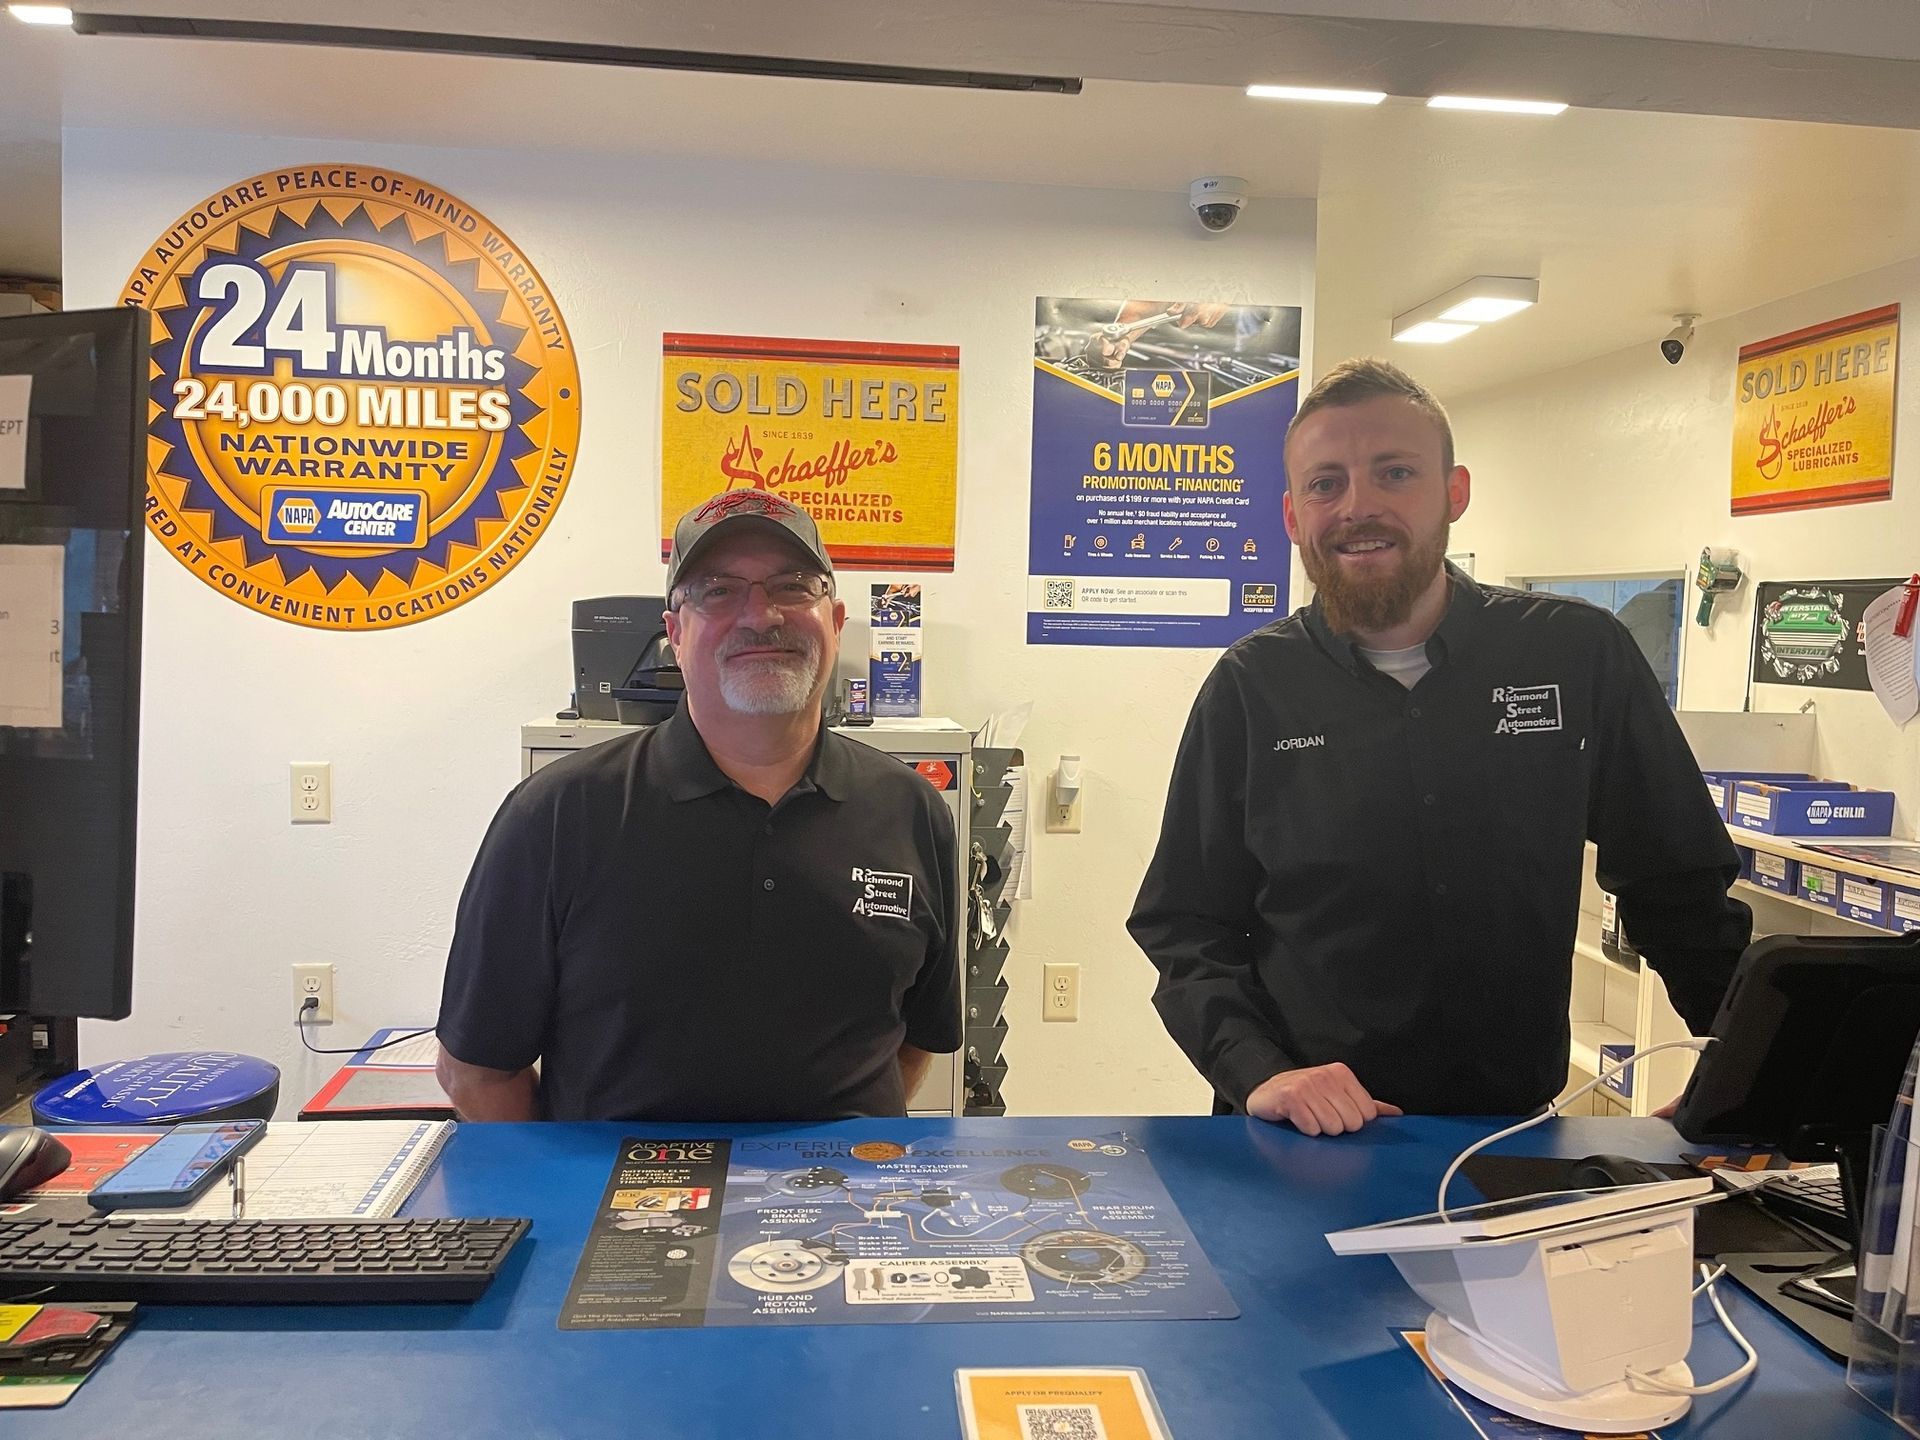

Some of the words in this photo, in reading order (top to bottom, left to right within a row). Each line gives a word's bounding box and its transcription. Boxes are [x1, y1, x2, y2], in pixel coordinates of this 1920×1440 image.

[124, 268, 159, 307] APA
[156, 181, 268, 263] AUTOCARE
[277, 170, 477, 233] PEACE-OF-MIND
[481, 231, 565, 352] WARRANTY
[197, 261, 337, 371] 24
[339, 329, 506, 381] Months
[1741, 359, 1807, 403] SOLD
[1814, 336, 1890, 387] HERE
[1155, 381, 1172, 391] NAPA
[172, 379, 348, 428] 24,000
[359, 386, 512, 431] MILES
[676, 371, 808, 416] SOLD
[823, 377, 947, 423] HERE
[762, 430, 789, 439] SINCE
[1756, 396, 1857, 468] Schaeffer's
[220, 433, 469, 460] NATIONWIDE
[1787, 441, 1853, 460] SPECIALIZED
[721, 424, 898, 491] Schaeffer's
[1093, 442, 1111, 471] 6
[1118, 442, 1235, 474] MONTHS
[1793, 452, 1859, 471] LUBRICANTS
[233, 457, 456, 481] WARRANTY
[1083, 475, 1171, 490] PROMOTIONAL
[778, 491, 893, 507] SPECIALIZED
[1086, 494, 1117, 503] purchases
[1125, 494, 1142, 502] $199
[1182, 497, 1196, 505] your
[1197, 496, 1214, 504] NAPA
[1215, 496, 1234, 504] Credit
[1235, 497, 1249, 505] Card
[284, 507, 316, 525] NAPA
[803, 507, 903, 523] BRICANTS
[1190, 512, 1220, 520] acceptance
[175, 542, 206, 567] AT
[208, 565, 356, 624] CONVENIENT
[365, 567, 488, 623] LOCATIONS
[488, 447, 570, 572] NATIONALLY
[344, 519, 396, 537] CENTER
[1780, 604, 1830, 612] INTERSTATE
[50, 620, 59, 635] 3
[1777, 648, 1827, 656] INTERSTATE
[1492, 687, 1549, 703] Richmond
[1506, 703, 1542, 718] Street
[1494, 718, 1556, 734] Automotive
[1273, 735, 1325, 751] JORDAN
[1810, 806, 1829, 818] NAPA
[1832, 806, 1866, 819] ECHLIN
[851, 867, 904, 887] Richmond
[864, 884, 897, 899] Street
[852, 897, 907, 915] Automotive
[133, 1053, 238, 1108] QUALITY
[101, 1076, 154, 1109] CHASSIS
[741, 1141, 851, 1151] EXPERIE
[802, 1151, 851, 1159] BRA
[911, 1149, 1053, 1158] EXCELLENCE
[752, 1307, 817, 1315] ASSEMBLY
